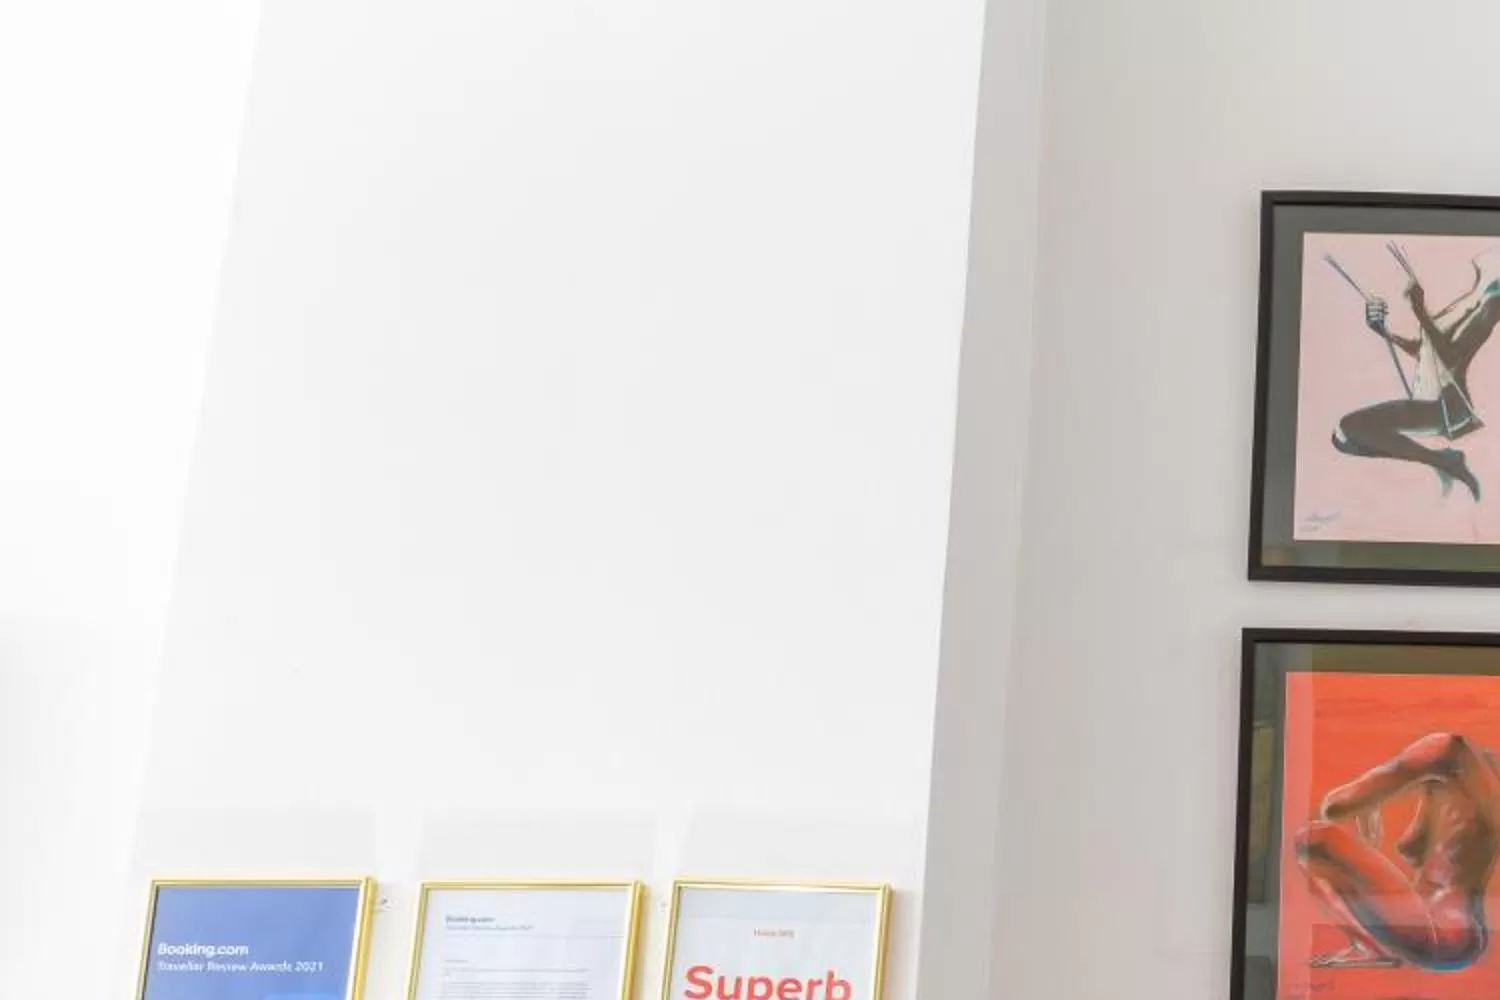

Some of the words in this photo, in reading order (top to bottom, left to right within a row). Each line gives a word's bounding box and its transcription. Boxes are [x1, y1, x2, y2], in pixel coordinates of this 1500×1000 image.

[157, 943, 249, 957] Booking.com
[249, 961, 292, 972] Awards
[294, 961, 324, 973] 2021
